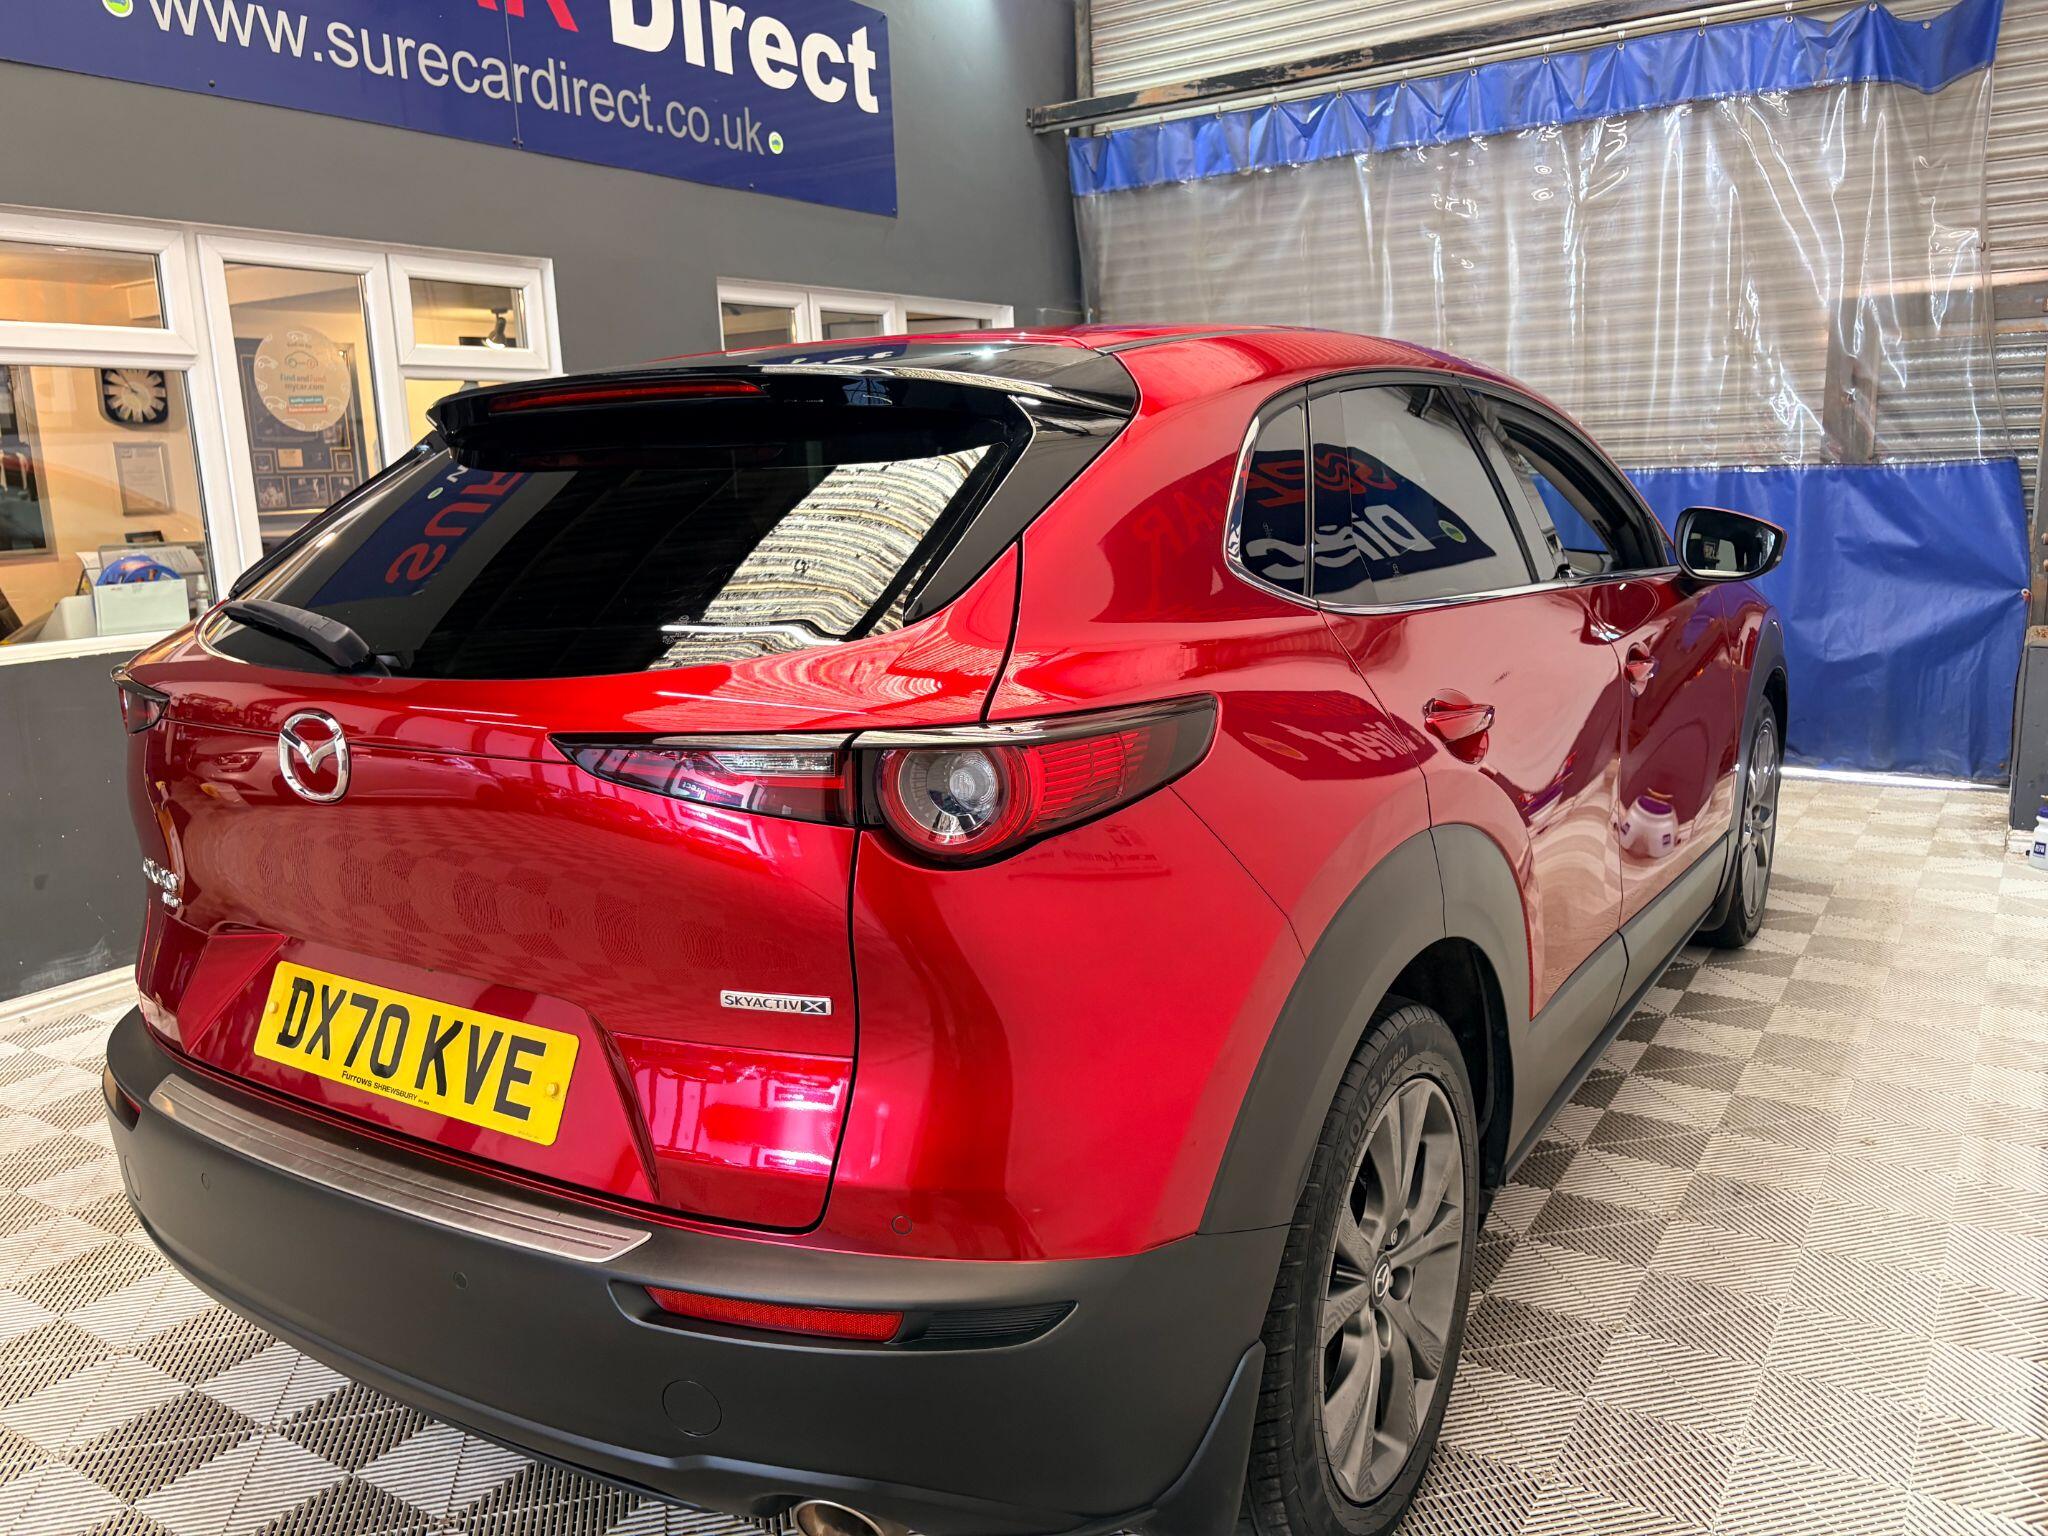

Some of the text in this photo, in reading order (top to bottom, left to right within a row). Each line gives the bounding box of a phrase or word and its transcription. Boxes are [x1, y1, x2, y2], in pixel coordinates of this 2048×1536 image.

[150, 0, 765, 155] www.surecardirect.co.uk
[276, 976, 547, 1121] DX70 KVE
[341, 1070, 418, 1101] Furrows SHREWSBURY
